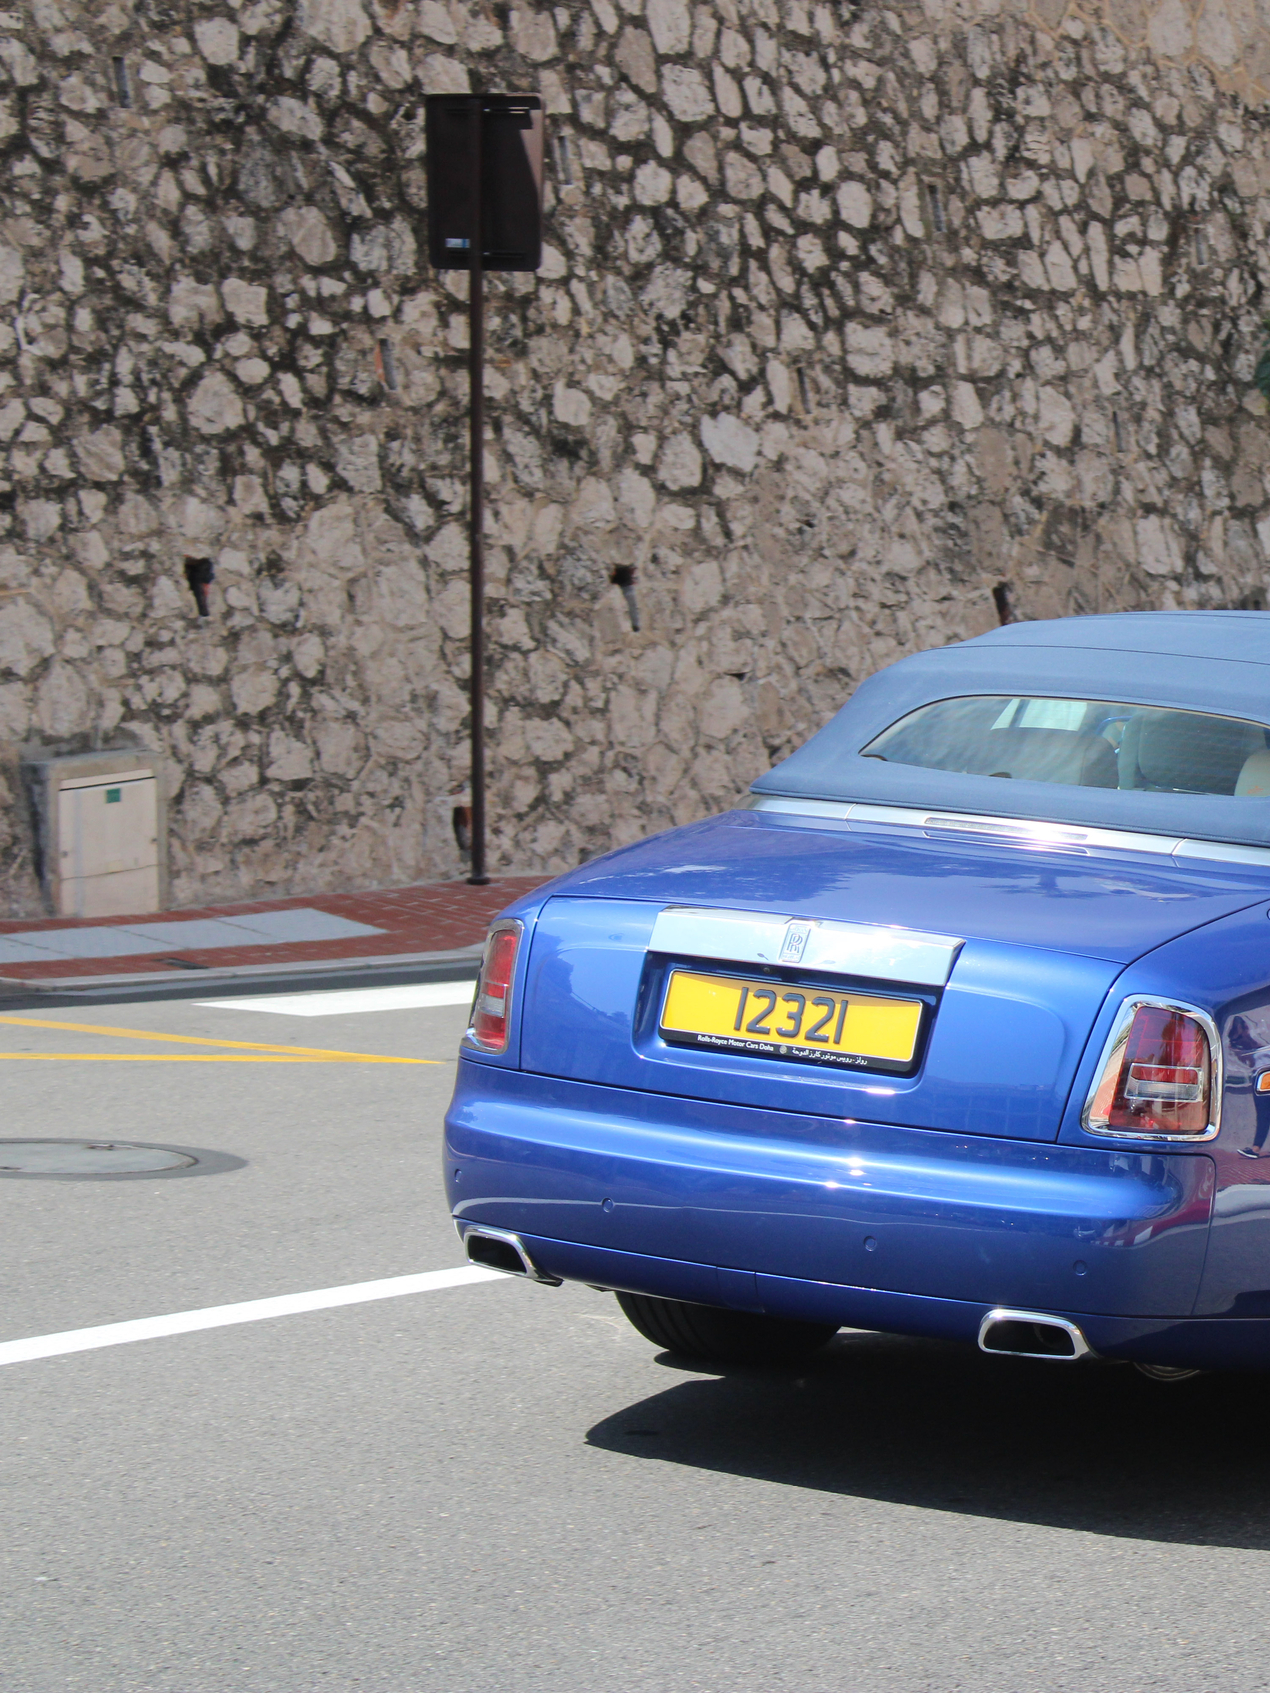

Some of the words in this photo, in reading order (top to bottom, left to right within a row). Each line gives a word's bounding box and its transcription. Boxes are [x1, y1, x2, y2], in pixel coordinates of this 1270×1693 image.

[733, 987, 849, 1044] 12321
[697, 1035, 728, 1046] Rolls-Royce
[728, 1039, 745, 1048] Motor
[746, 1041, 759, 1049] Cars
[759, 1043, 774, 1051] Doha
